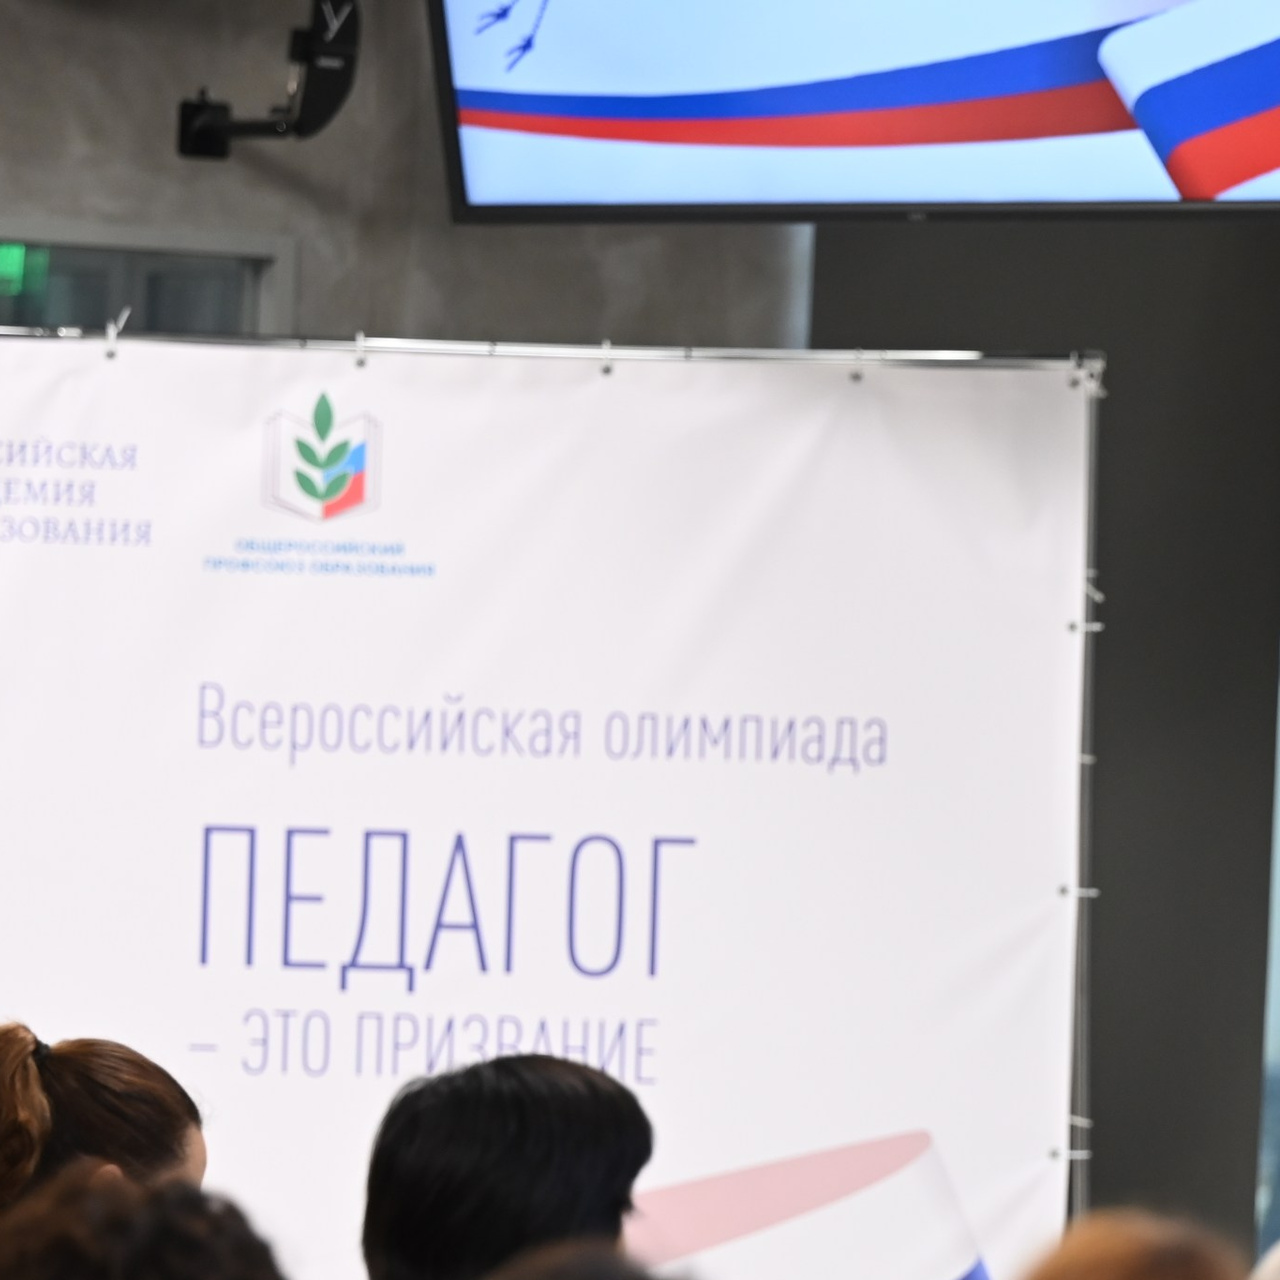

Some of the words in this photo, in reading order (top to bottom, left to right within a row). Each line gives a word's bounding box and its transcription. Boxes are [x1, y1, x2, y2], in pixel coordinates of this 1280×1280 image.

[0, 436, 138, 470] ИЙСКАЯ
[197, 681, 583, 768] Всероссийская
[602, 709, 889, 774] олимпиада
[199, 825, 697, 993] ПЕДАГОГ
[241, 1007, 332, 1077] ЭТО
[354, 1010, 658, 1086] ПРИЗВАНИЕ
